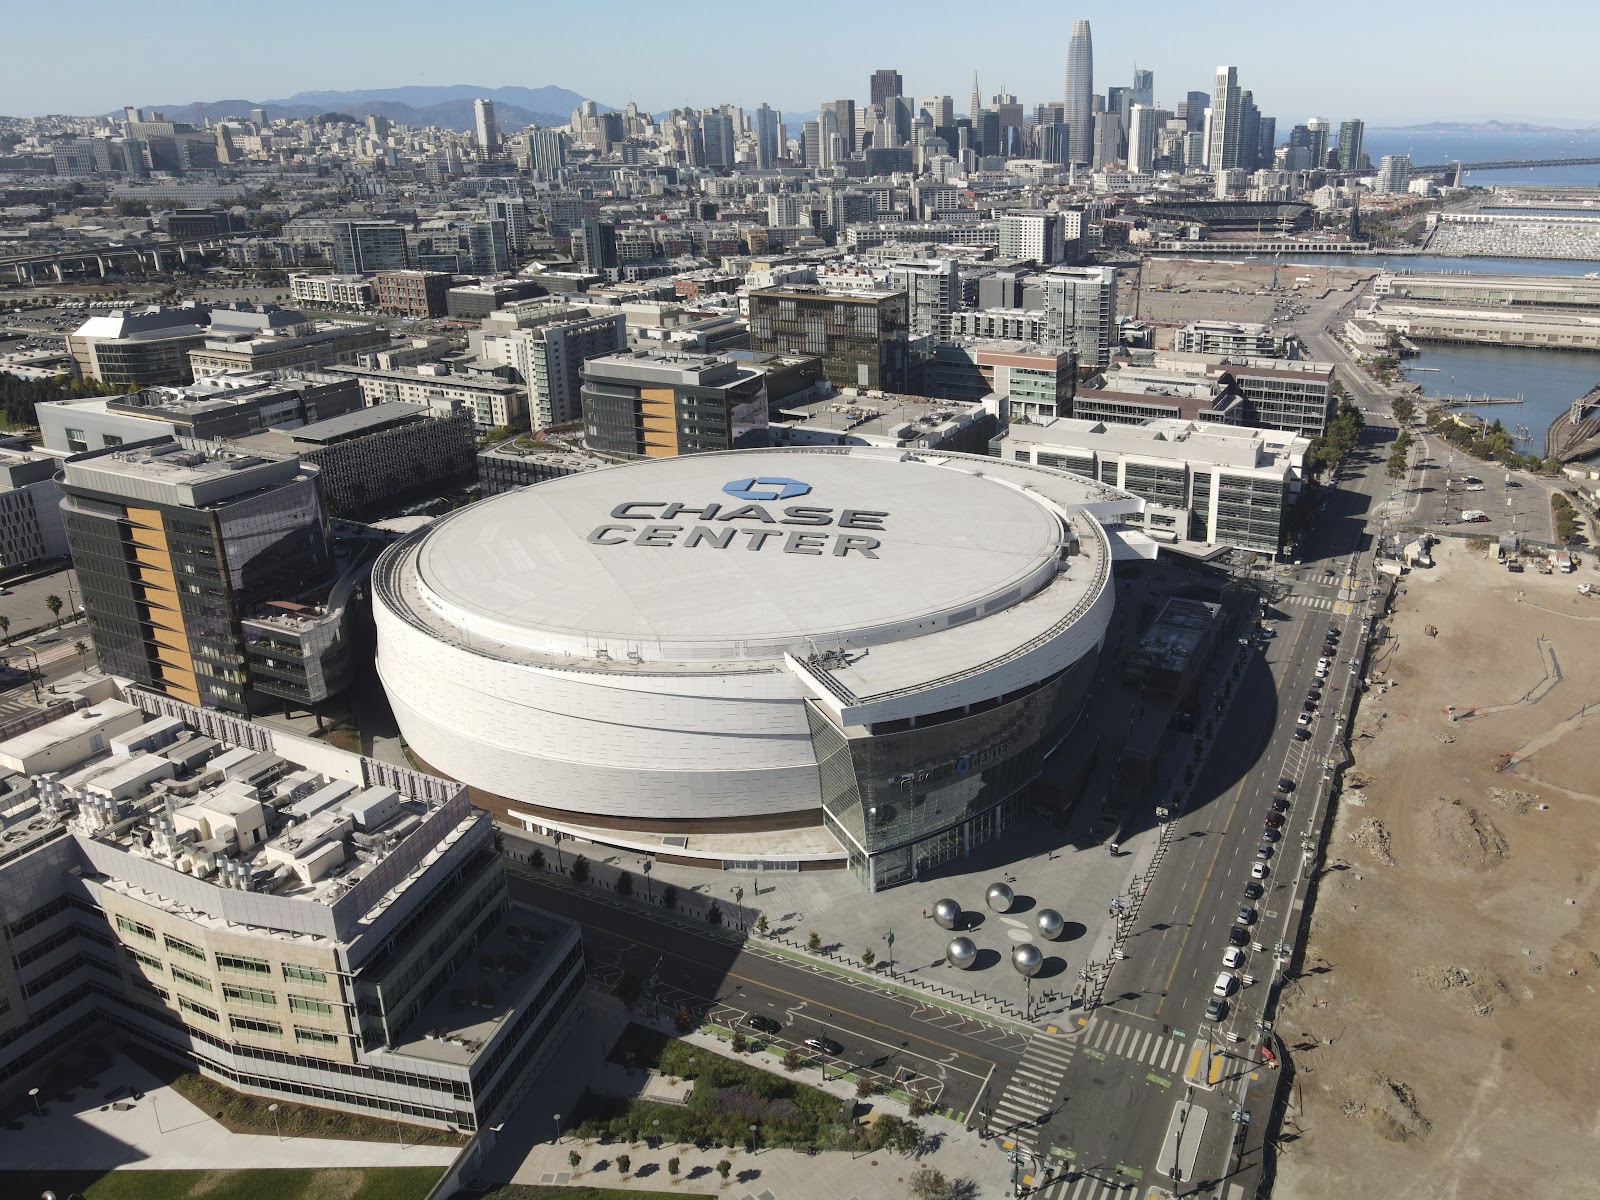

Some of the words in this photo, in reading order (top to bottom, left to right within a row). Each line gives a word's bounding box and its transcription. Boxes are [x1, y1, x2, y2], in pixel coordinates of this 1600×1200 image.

[610, 502, 889, 531] CHASE
[586, 524, 881, 559] CENTER
[971, 741, 1013, 767] CENTER
